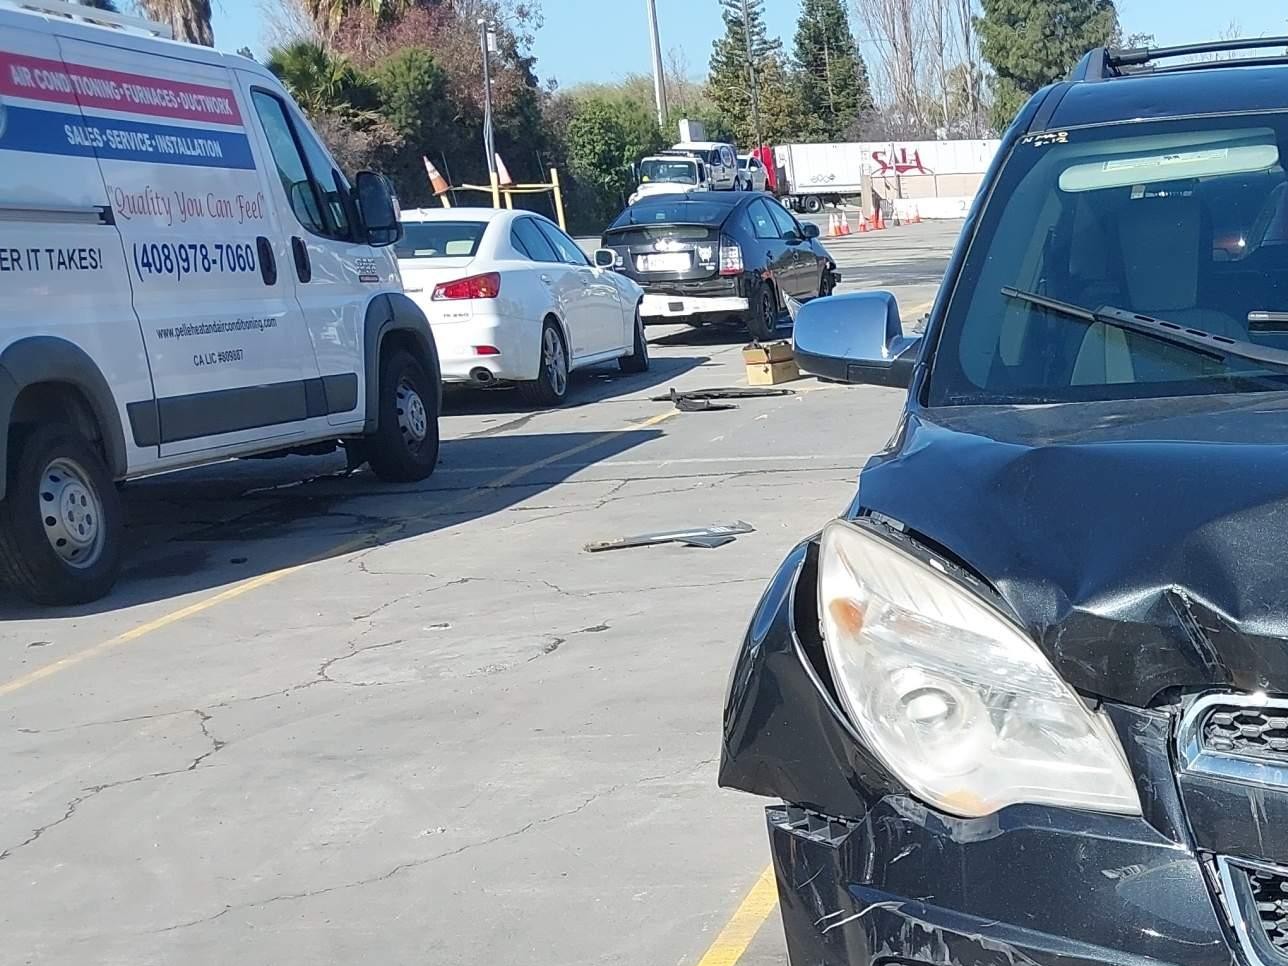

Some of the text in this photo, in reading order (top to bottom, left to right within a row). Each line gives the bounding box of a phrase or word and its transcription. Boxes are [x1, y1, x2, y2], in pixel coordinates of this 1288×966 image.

[10, 65, 36, 88] AIR
[64, 124, 103, 147] SALES
[174, 191, 204, 223] You
[206, 192, 234, 218] Can
[26, 248, 41, 271] IT
[45, 248, 103, 271] TAKES!
[133, 243, 256, 282] (408)978-7060
[193, 353, 205, 367] CA
[205, 351, 218, 365] LIC
